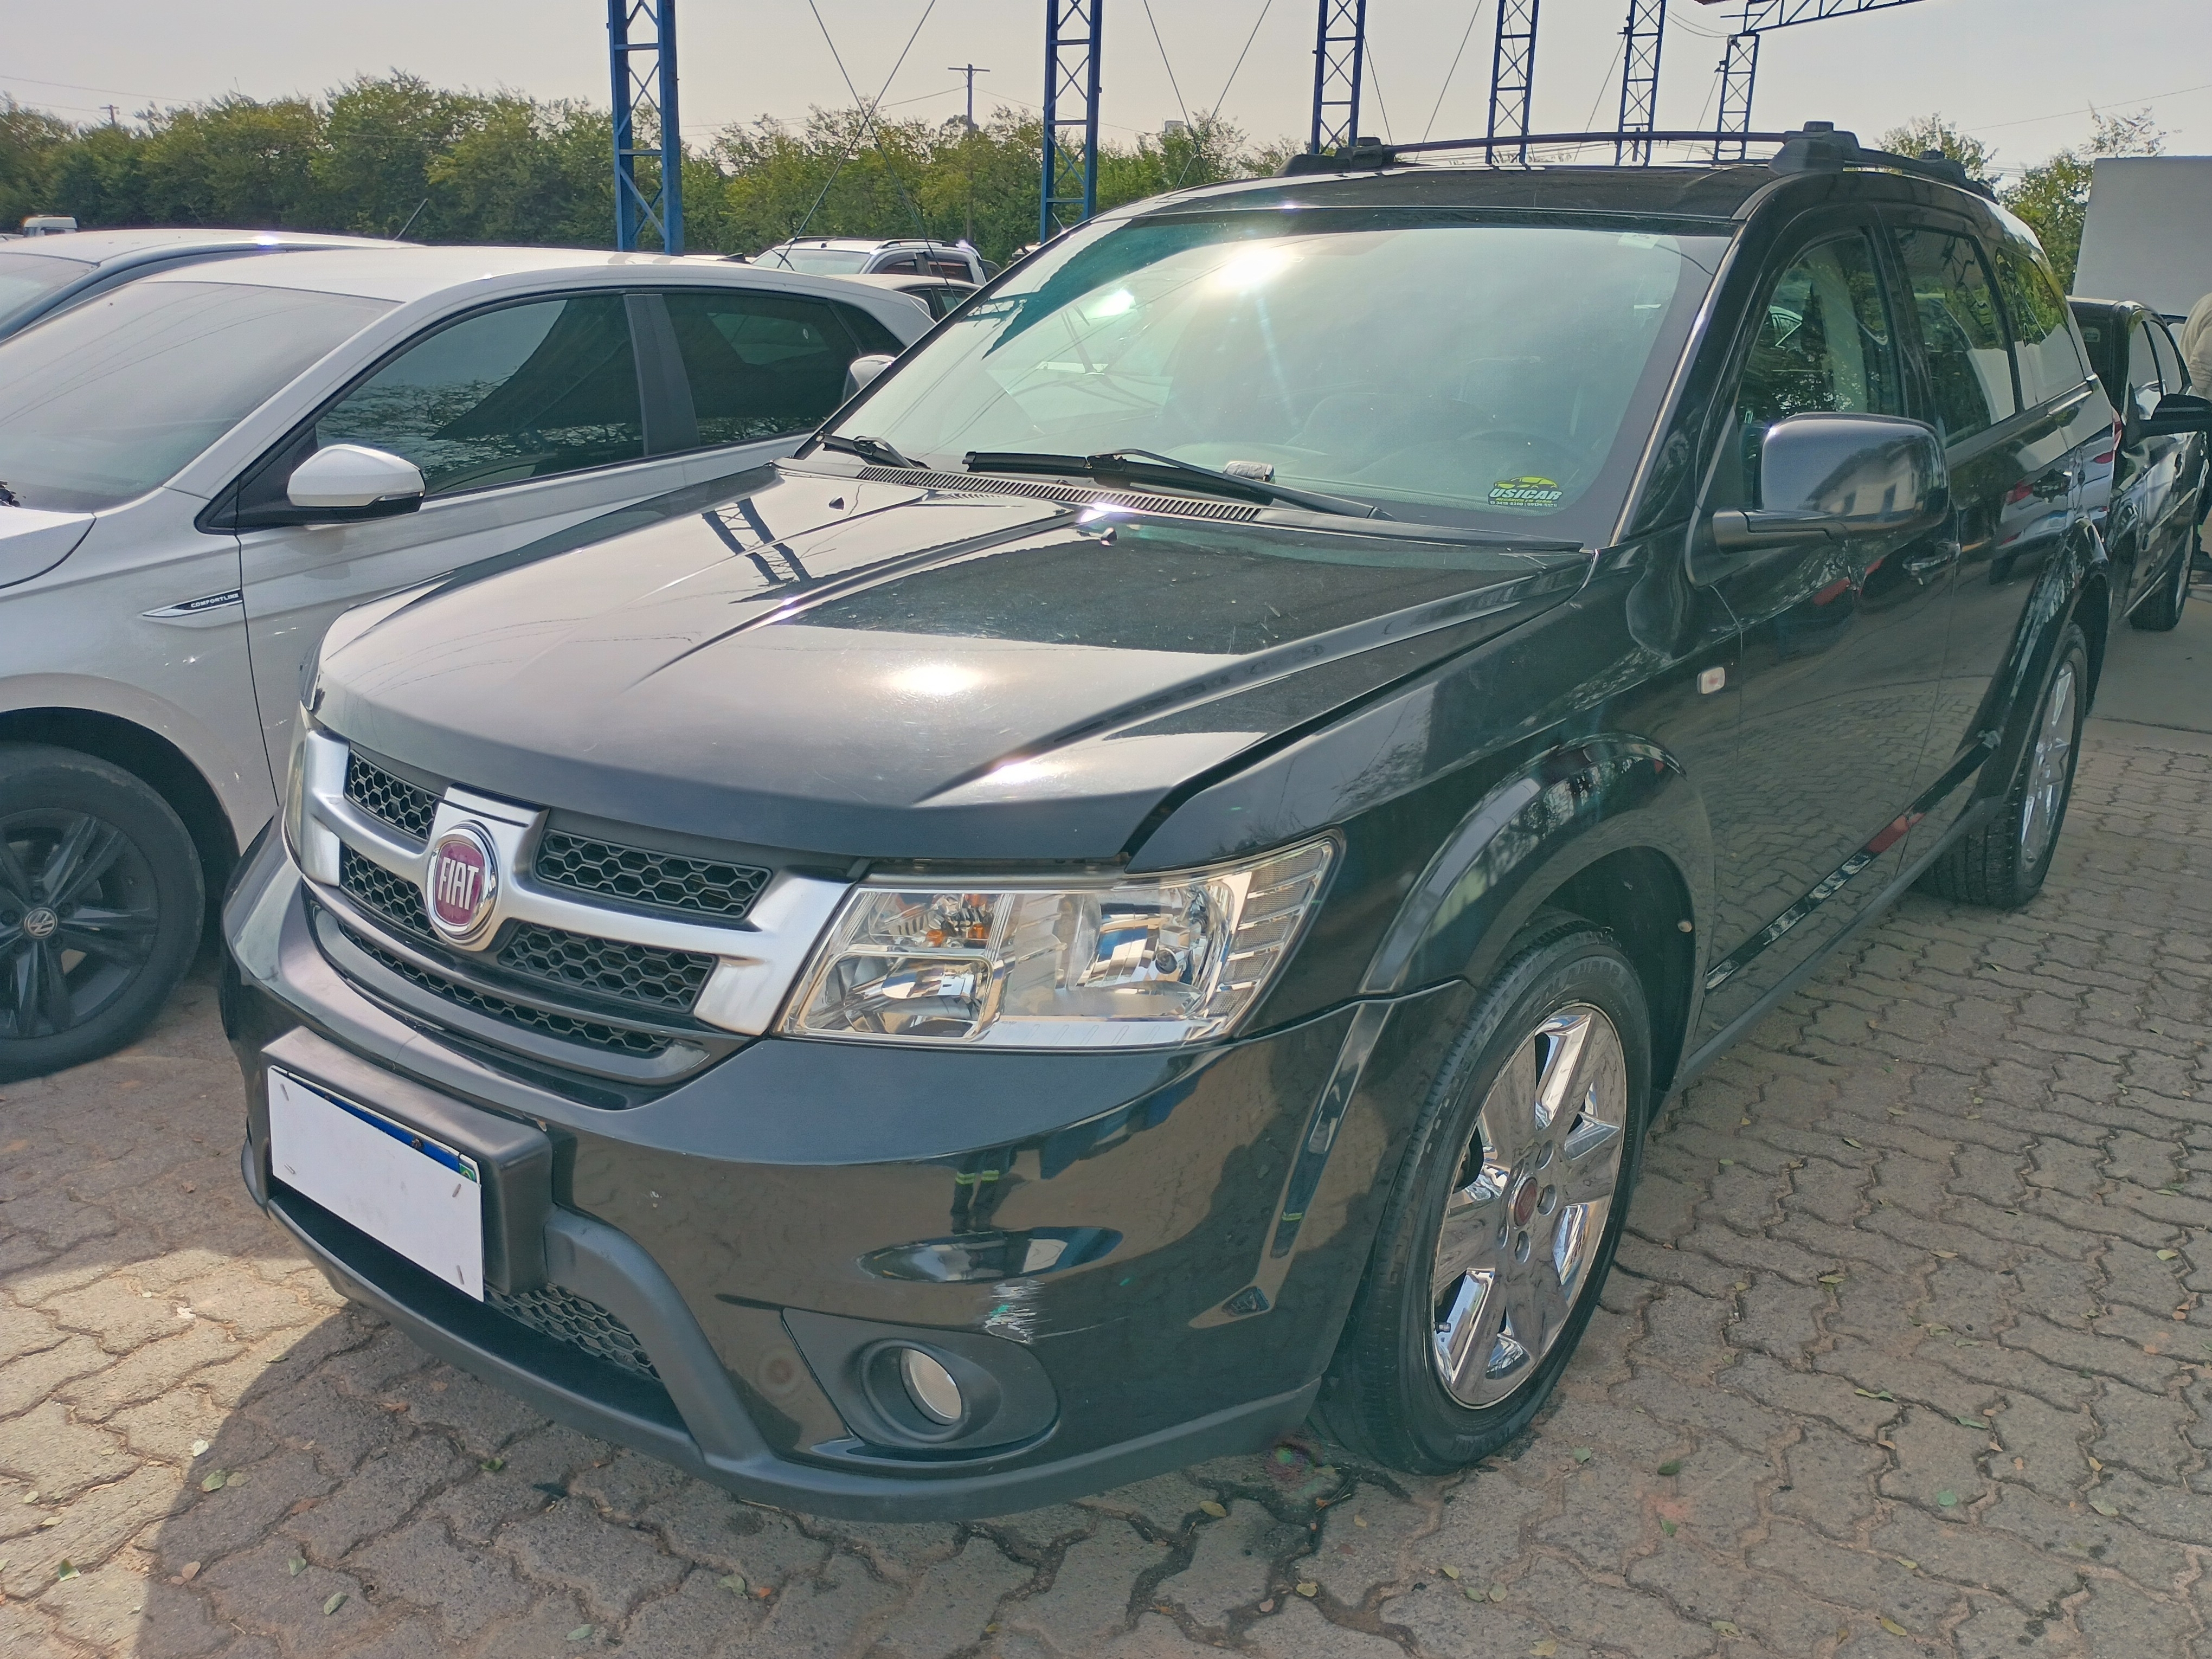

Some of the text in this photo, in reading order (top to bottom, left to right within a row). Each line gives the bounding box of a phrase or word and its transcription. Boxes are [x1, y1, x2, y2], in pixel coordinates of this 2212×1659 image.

[1489, 488, 1562, 500] USICAR
[190, 593, 240, 608] COMFORTLINE
[437, 856, 479, 910] FIAT
